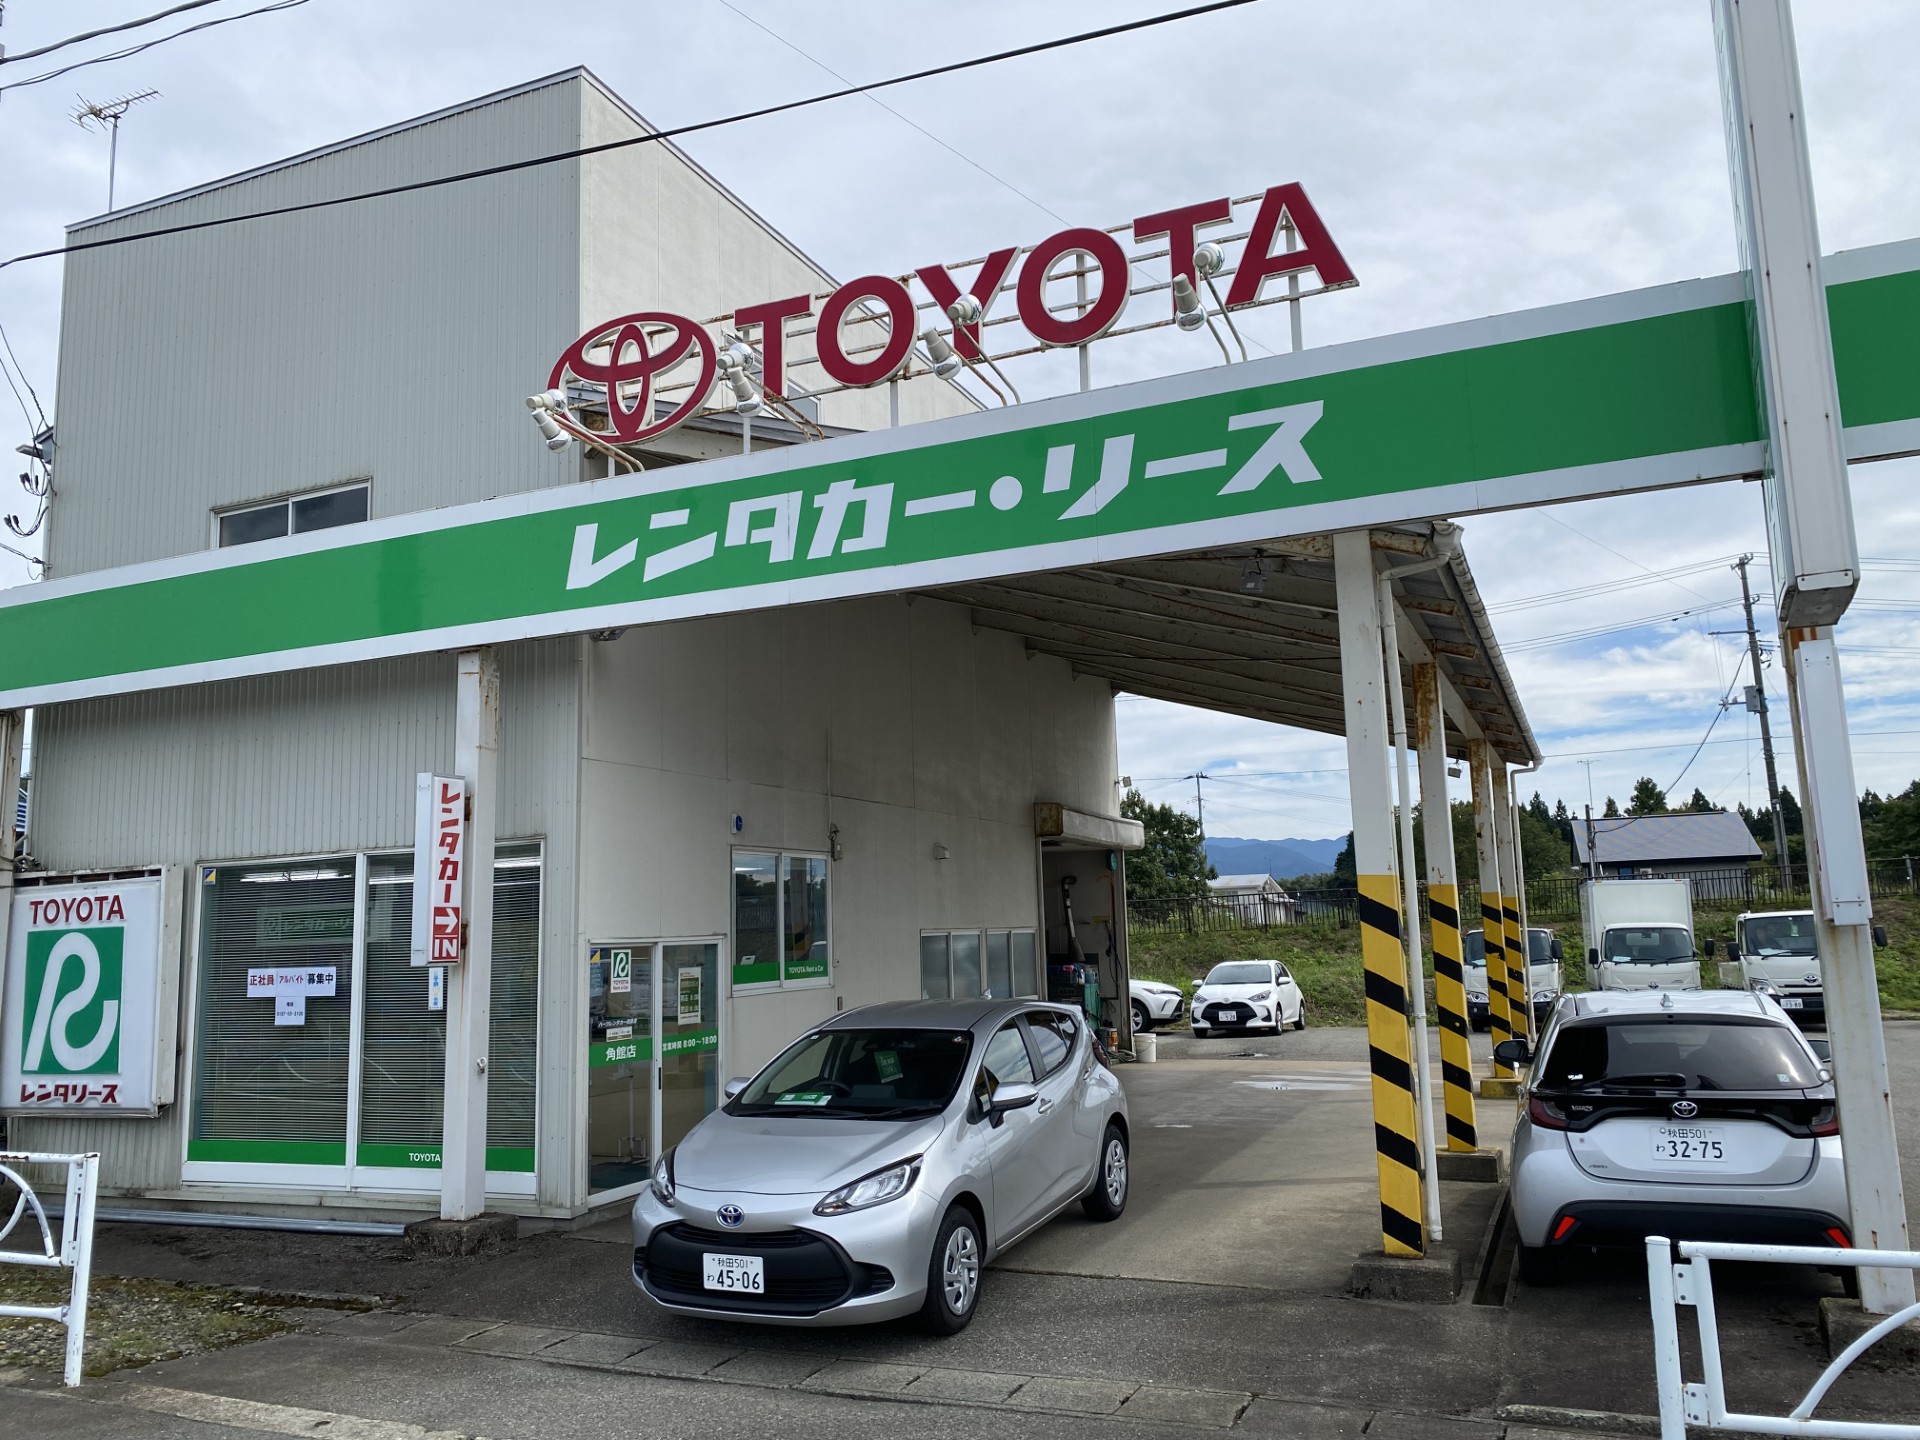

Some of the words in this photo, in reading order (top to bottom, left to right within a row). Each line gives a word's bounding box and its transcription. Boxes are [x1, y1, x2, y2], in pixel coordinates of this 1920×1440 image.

[735, 181, 1360, 398] TOYOTA
[566, 400, 1325, 591] レンタカー・リース
[438, 783, 461, 903] レンタカー
[29, 895, 125, 925] TOYOTA
[434, 938, 457, 958] IN
[249, 974, 275, 986] 正社員
[279, 974, 304, 984] アルバイト
[307, 973, 334, 985] 募集中
[788, 966, 805, 974] TOYOTA
[605, 1045, 637, 1061] 角館店
[19, 1084, 119, 1104] レンタリース
[408, 1153, 441, 1162] TOYOTA
[1656, 1144, 1666, 1153] わ
[1667, 1140, 1723, 1159] 32-75
[706, 1273, 715, 1282] わ
[717, 1269, 760, 1290] 45-06
